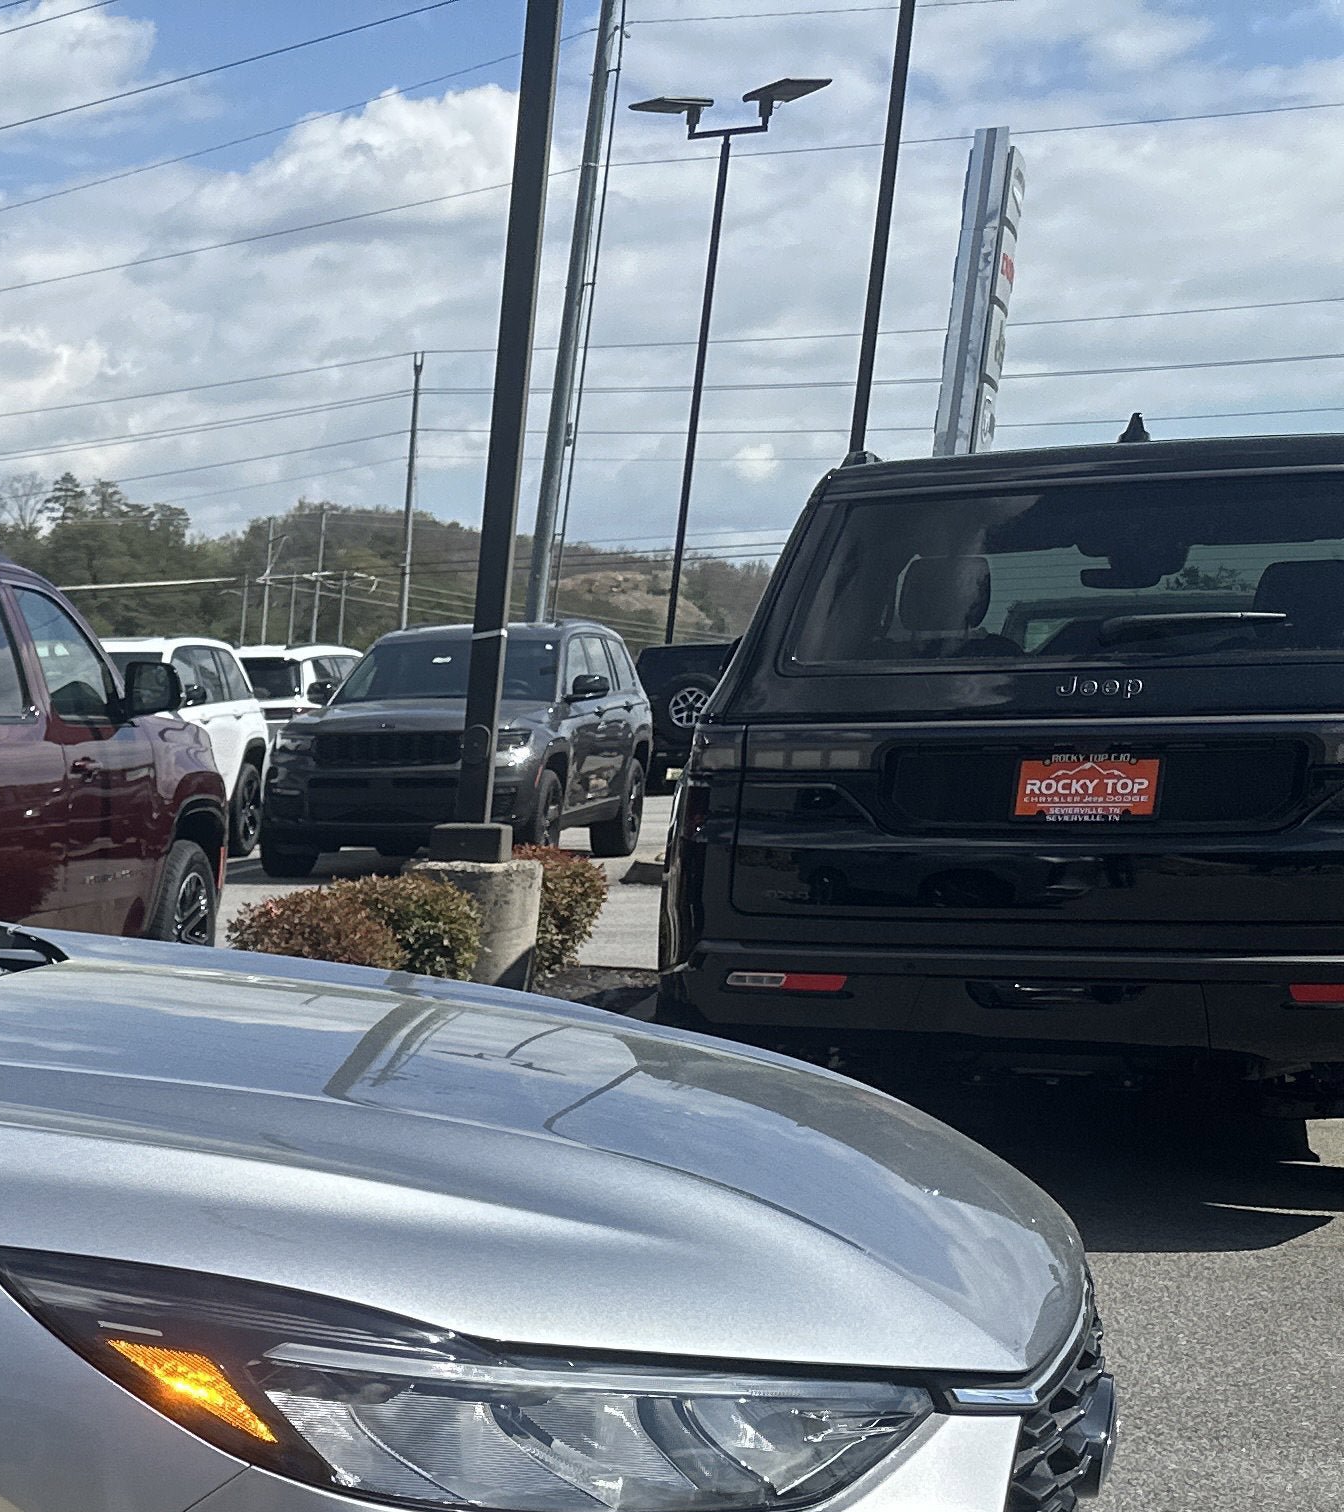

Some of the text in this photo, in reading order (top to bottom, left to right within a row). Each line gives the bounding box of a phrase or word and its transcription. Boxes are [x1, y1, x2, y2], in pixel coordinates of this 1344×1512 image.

[1056, 676, 1143, 699] Jeep
[1052, 754, 1085, 763] ROCKY
[1089, 754, 1109, 763] TOP
[1025, 778, 1149, 794] ROCKY TOP
[1083, 795, 1104, 803] Jeep
